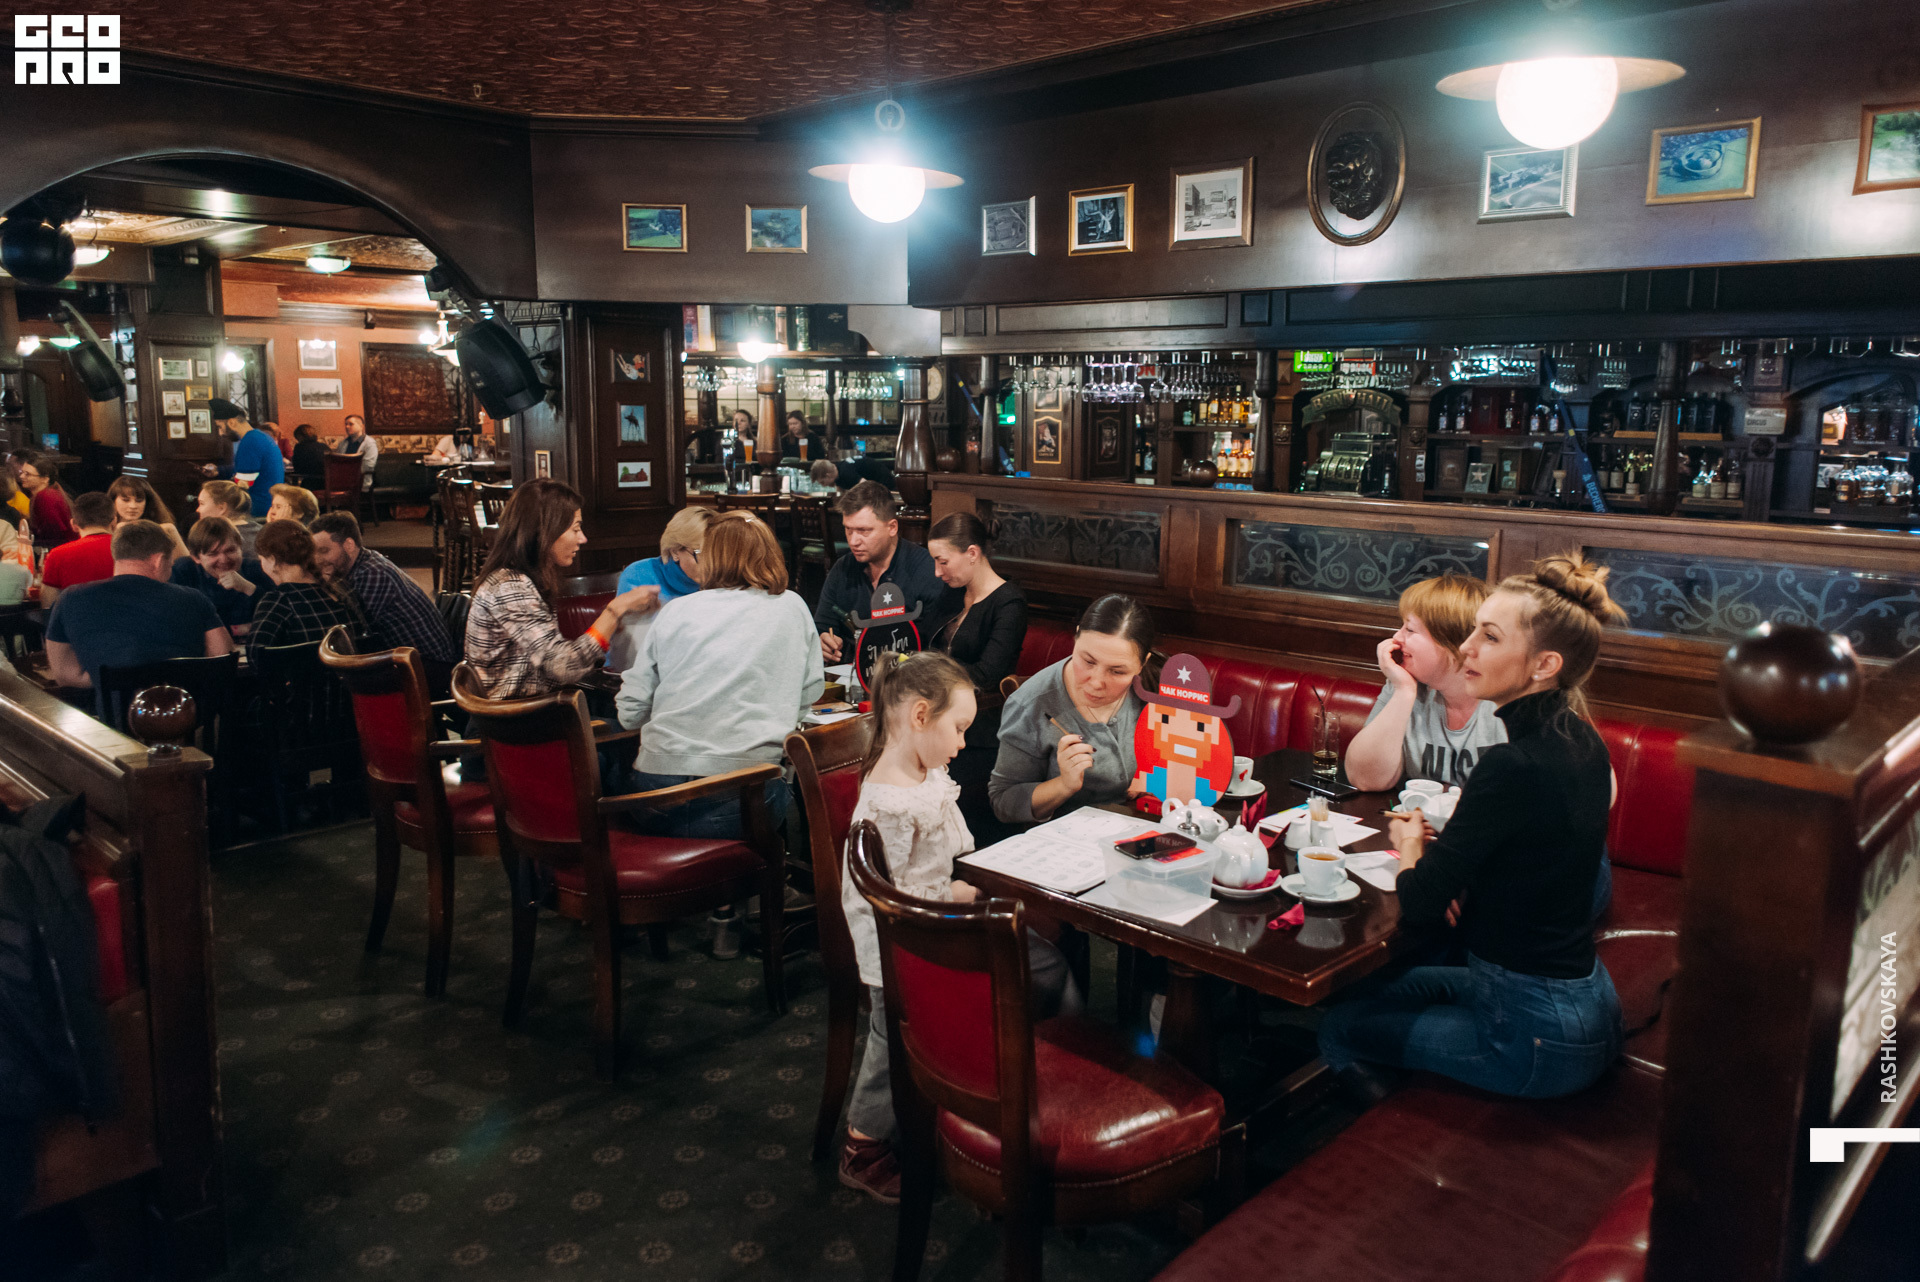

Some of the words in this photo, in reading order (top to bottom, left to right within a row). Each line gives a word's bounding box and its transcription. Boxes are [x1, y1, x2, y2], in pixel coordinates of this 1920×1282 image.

[1357, 392, 1389, 410] HALL
[1160, 685, 1176, 696] ЧАК
[1176, 687, 1209, 703] НОРРИС
